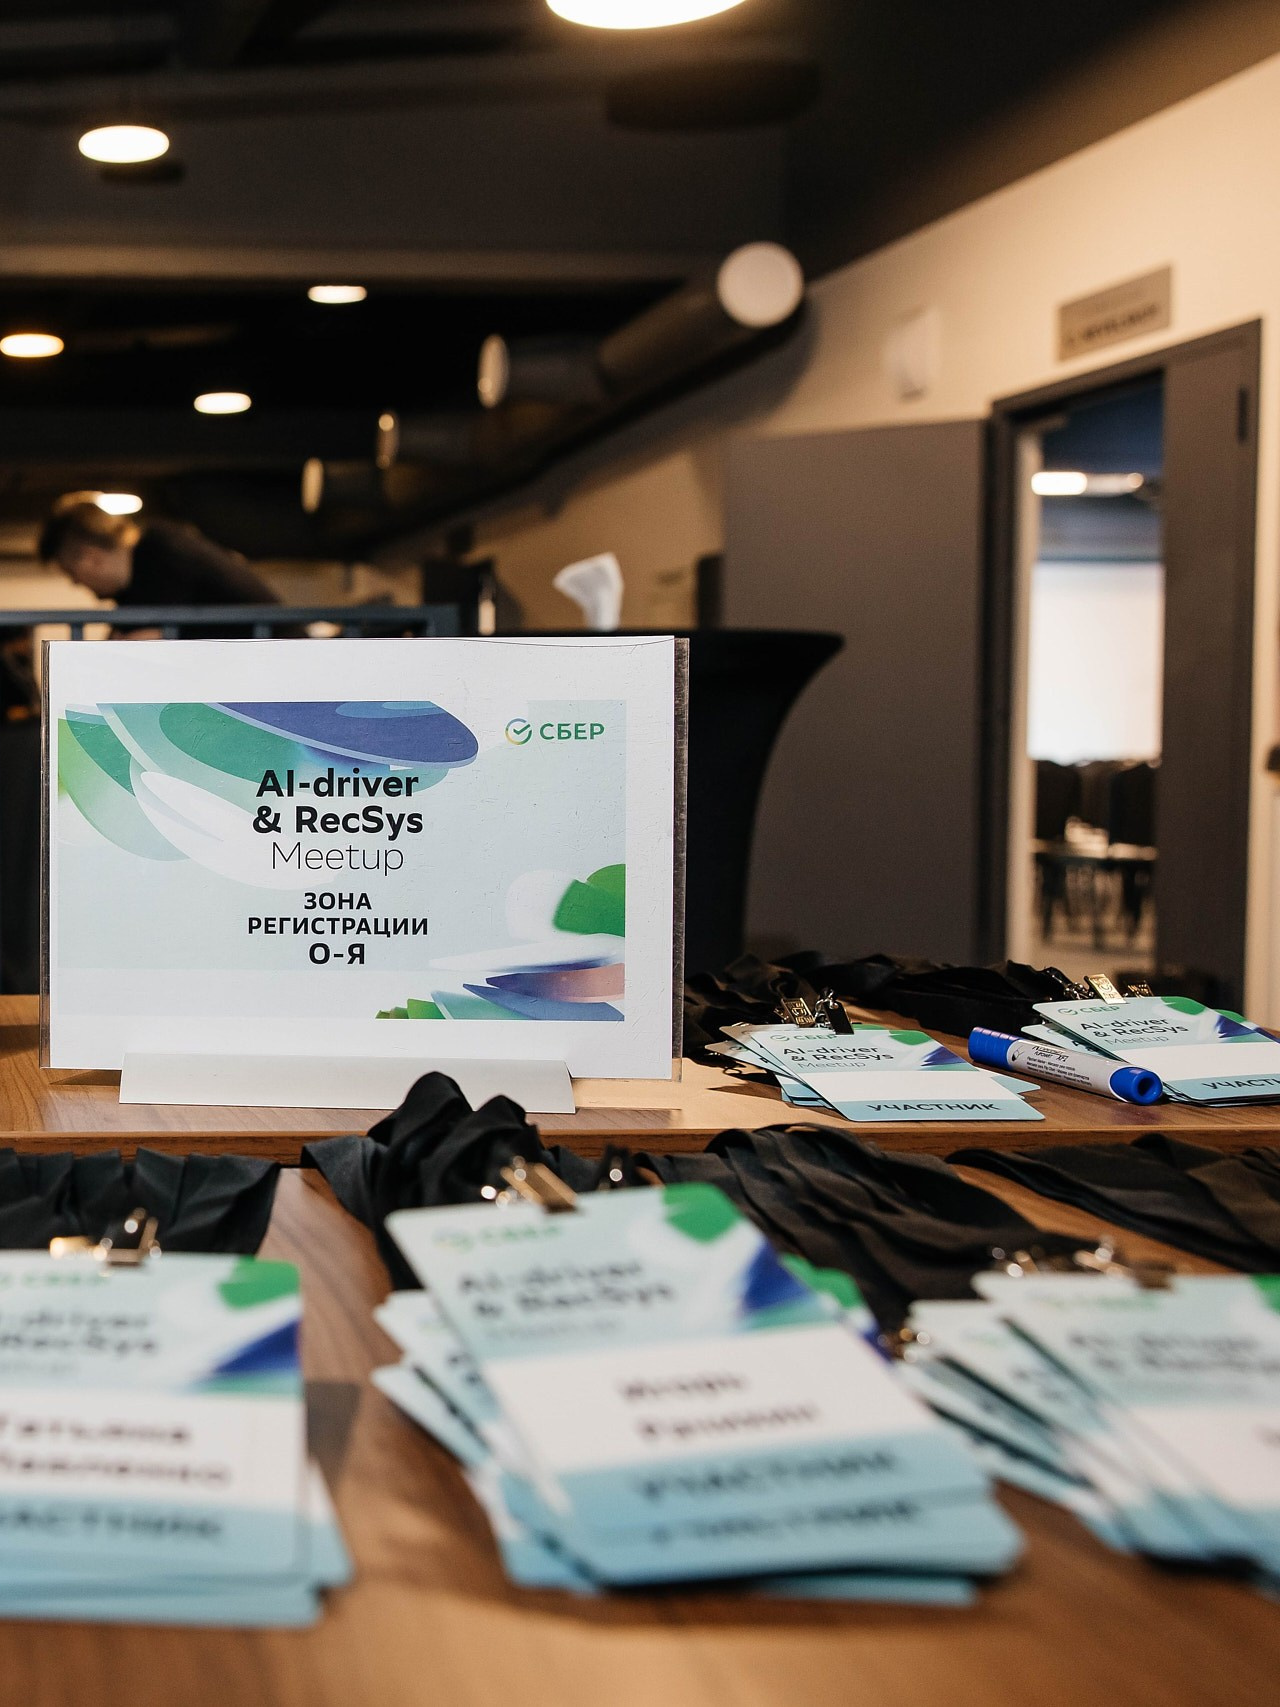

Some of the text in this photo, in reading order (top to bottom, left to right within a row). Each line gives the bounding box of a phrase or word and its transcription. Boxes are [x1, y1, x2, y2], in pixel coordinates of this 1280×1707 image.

[538, 722, 605, 741] СБЕР
[255, 767, 420, 798] AI-driver
[252, 804, 424, 841] & RecSys
[271, 841, 405, 877] Meetup
[303, 891, 373, 911] ЗОНА
[248, 916, 429, 938] РЕГИСТРАЦИИ
[308, 942, 366, 966] О-Я
[1080, 1006, 1120, 1014] СБЕР
[1080, 1018, 1169, 1032] AI-driver
[1093, 1025, 1190, 1039] & RecSys
[1104, 1036, 1169, 1046] Meetup
[782, 1045, 879, 1055] AI-driver
[811, 1053, 895, 1062] RecSys
[797, 1061, 867, 1069] Meetup
[1202, 1077, 1280, 1090] УЧАСТ
[866, 1103, 1002, 1112] УЧАСТНИК
